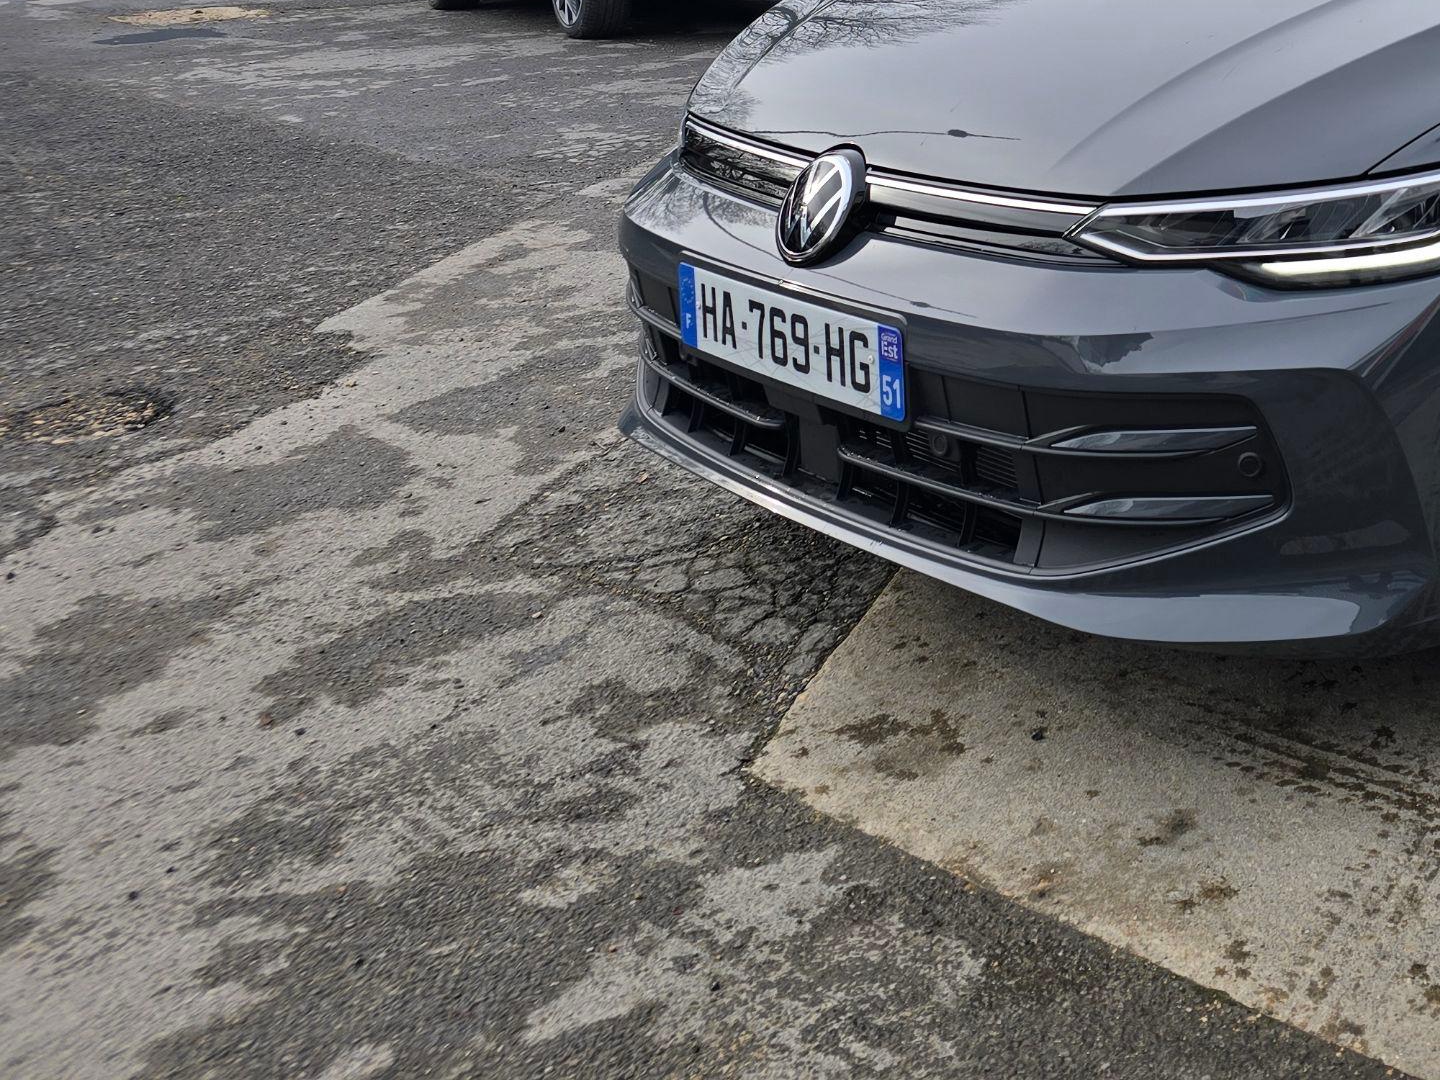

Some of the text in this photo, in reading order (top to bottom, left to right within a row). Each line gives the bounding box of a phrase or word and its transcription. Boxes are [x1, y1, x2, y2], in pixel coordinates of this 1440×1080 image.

[881, 332, 898, 344] Grand
[881, 340, 898, 359] Est
[882, 374, 901, 408] 51
